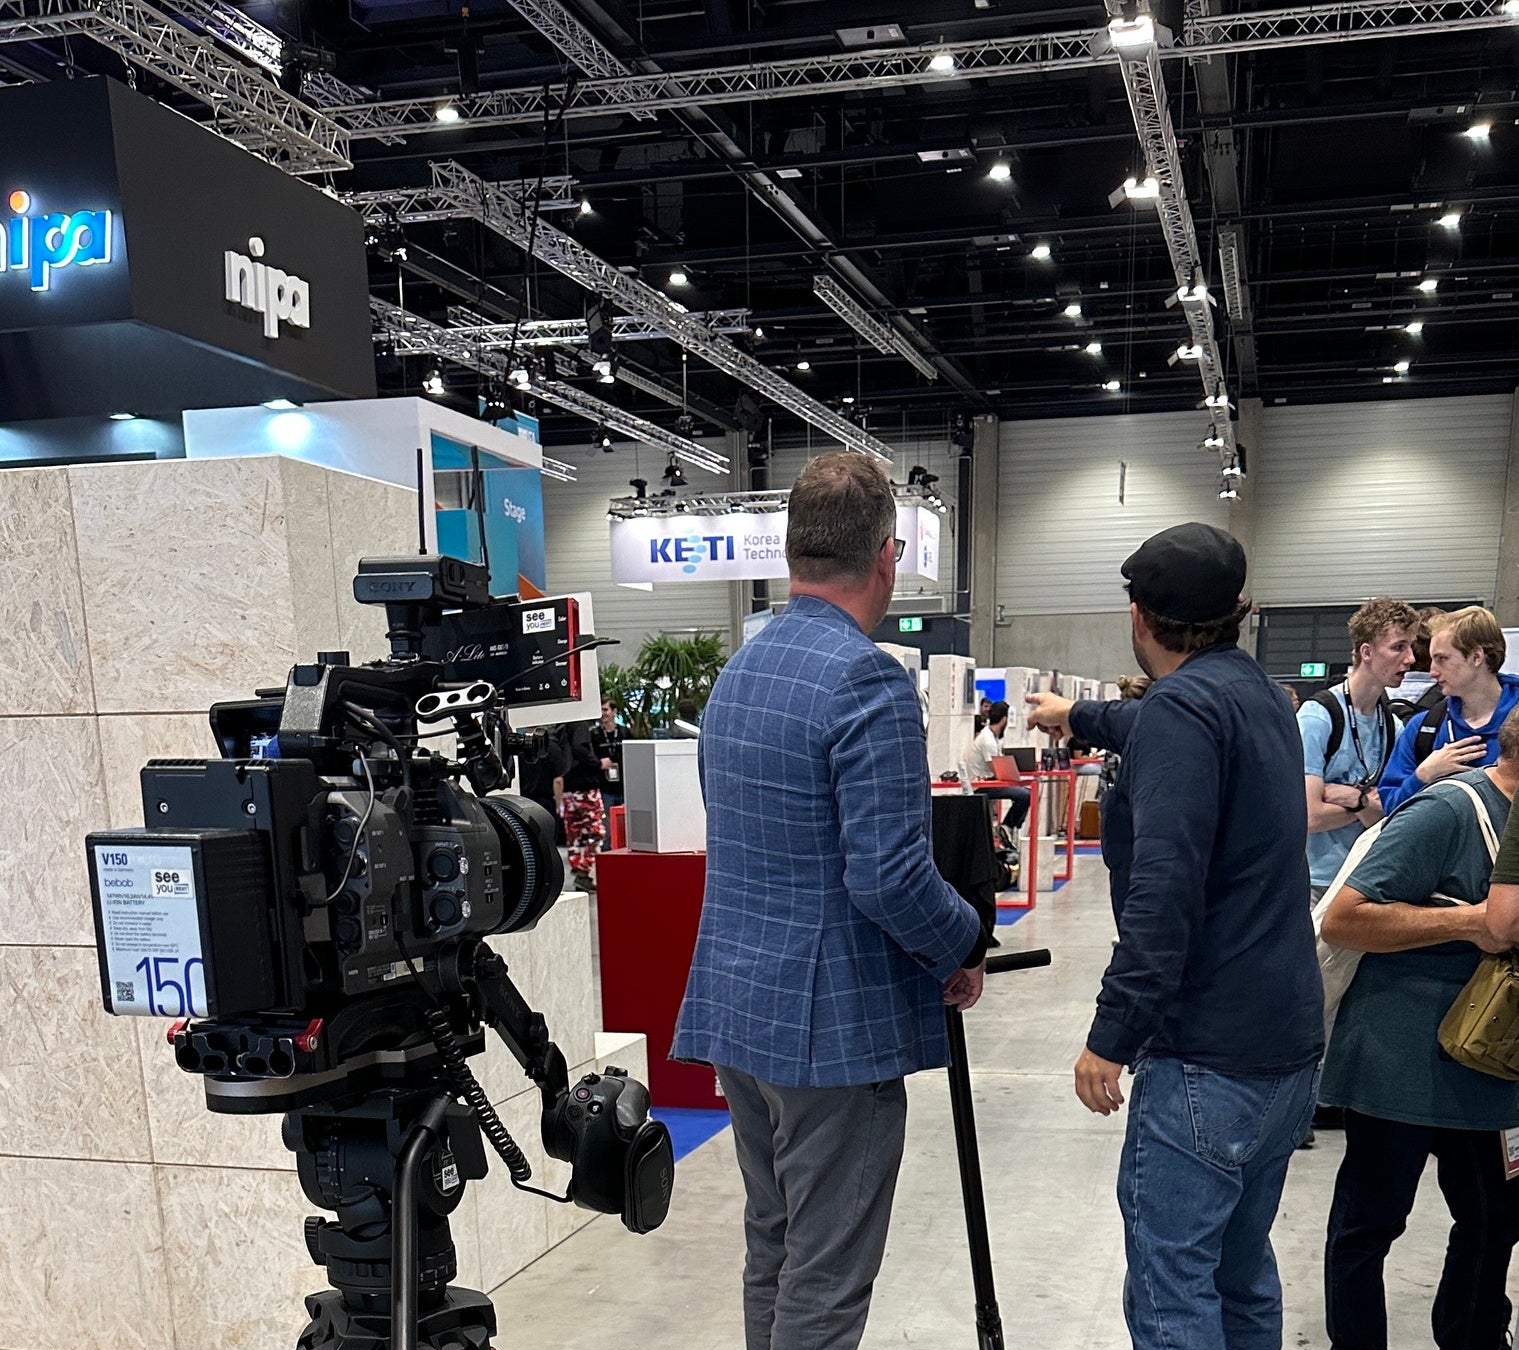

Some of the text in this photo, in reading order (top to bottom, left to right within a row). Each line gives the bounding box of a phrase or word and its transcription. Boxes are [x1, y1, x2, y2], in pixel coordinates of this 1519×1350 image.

[0, 189, 112, 291] ipa
[224, 236, 310, 339] nipa
[504, 498, 525, 523] Stage
[744, 534, 780, 546] Korea
[369, 579, 416, 593] SONY
[526, 611, 545, 622] see
[526, 621, 540, 631] you
[102, 853, 128, 865] V150
[104, 878, 133, 887] bebob
[155, 871, 180, 883] see
[156, 884, 174, 895] you
